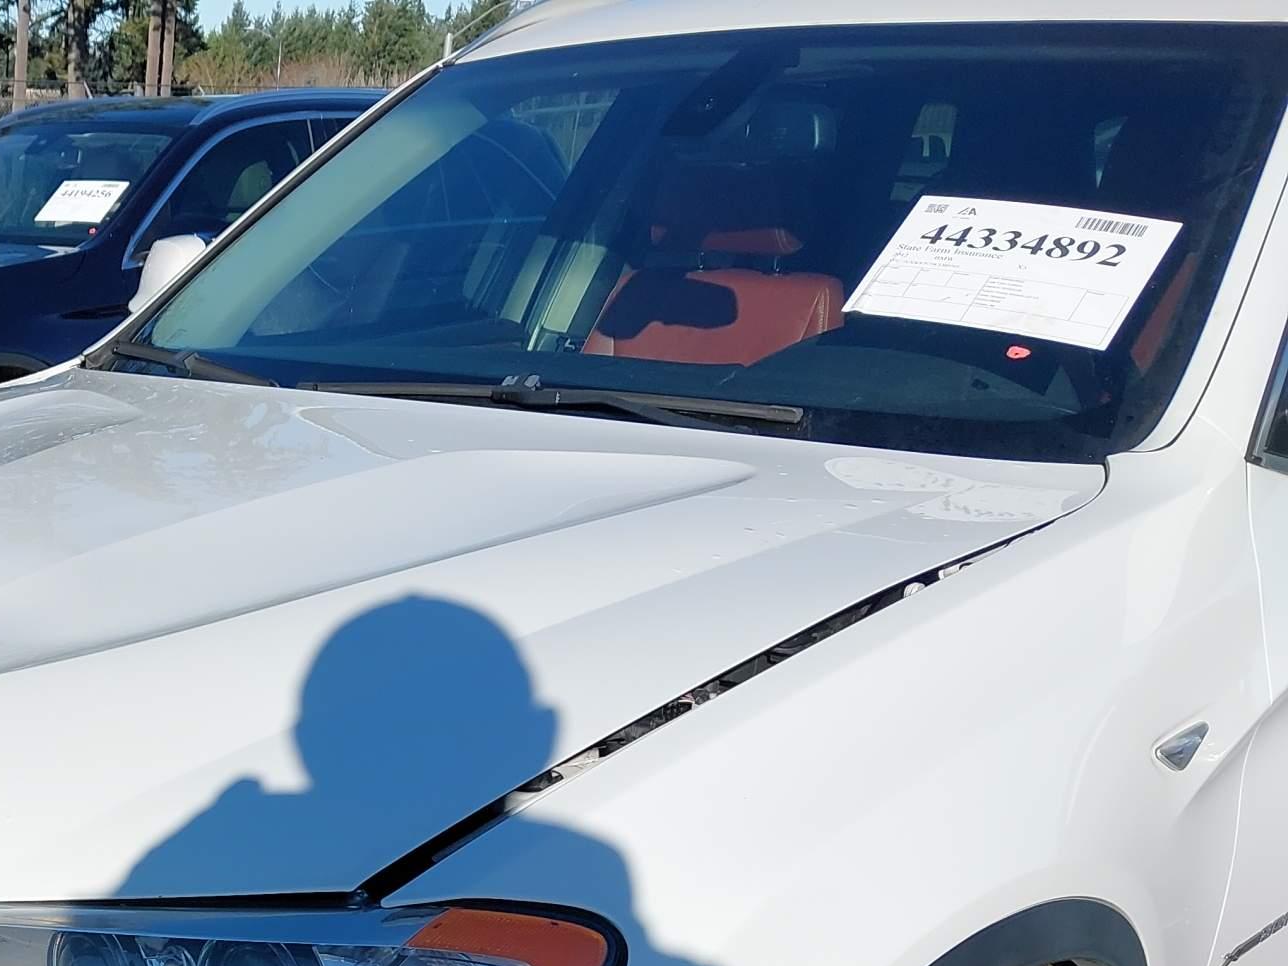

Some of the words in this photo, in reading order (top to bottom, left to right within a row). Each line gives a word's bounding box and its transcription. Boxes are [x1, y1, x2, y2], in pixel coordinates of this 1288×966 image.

[897, 243, 922, 252] State
[924, 245, 951, 255] Farm
[953, 247, 1004, 260] Insurance
[920, 224, 1127, 267] 44334892
